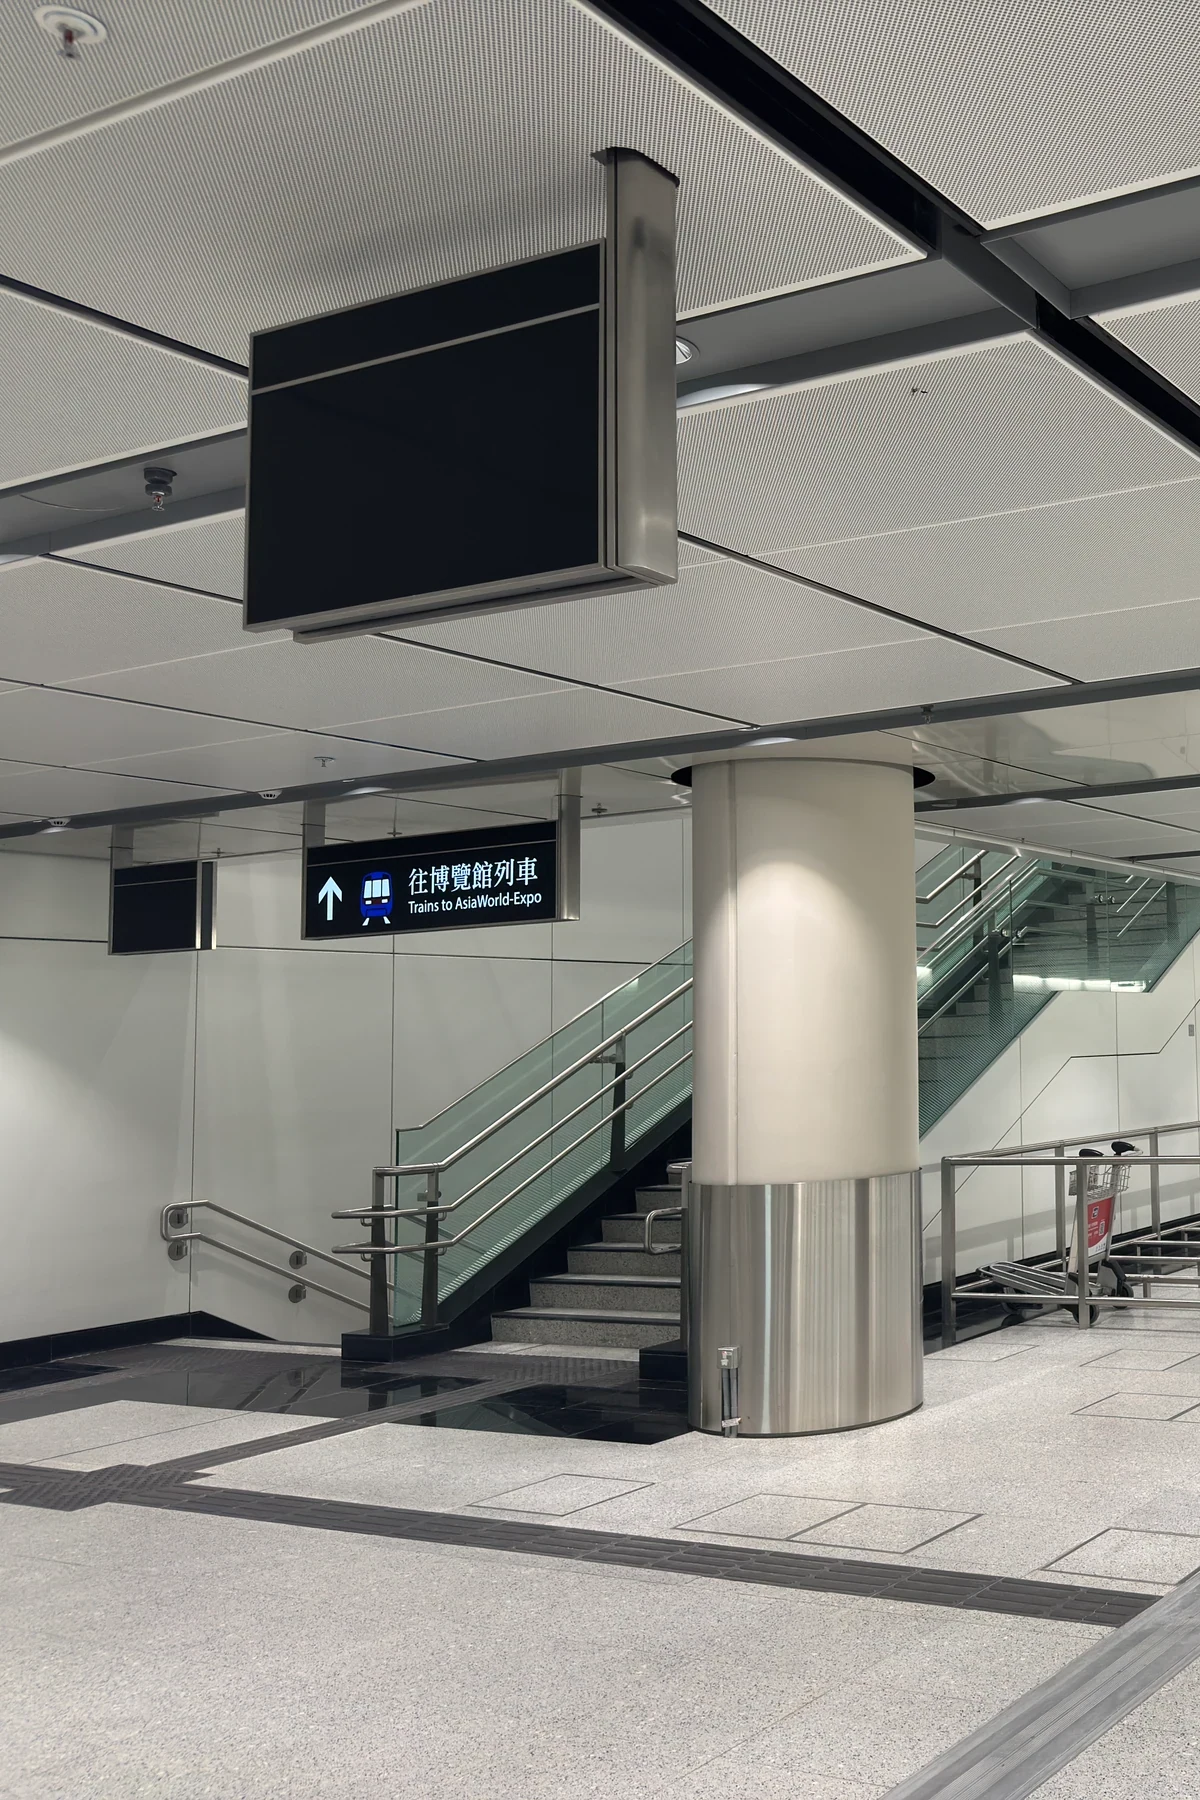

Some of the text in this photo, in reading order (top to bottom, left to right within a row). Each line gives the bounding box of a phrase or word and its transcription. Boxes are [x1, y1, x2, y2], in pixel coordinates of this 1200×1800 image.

[408, 857, 538, 896] 往博覽館列車
[408, 892, 542, 914] Trains to AsiaWorld-Expo
